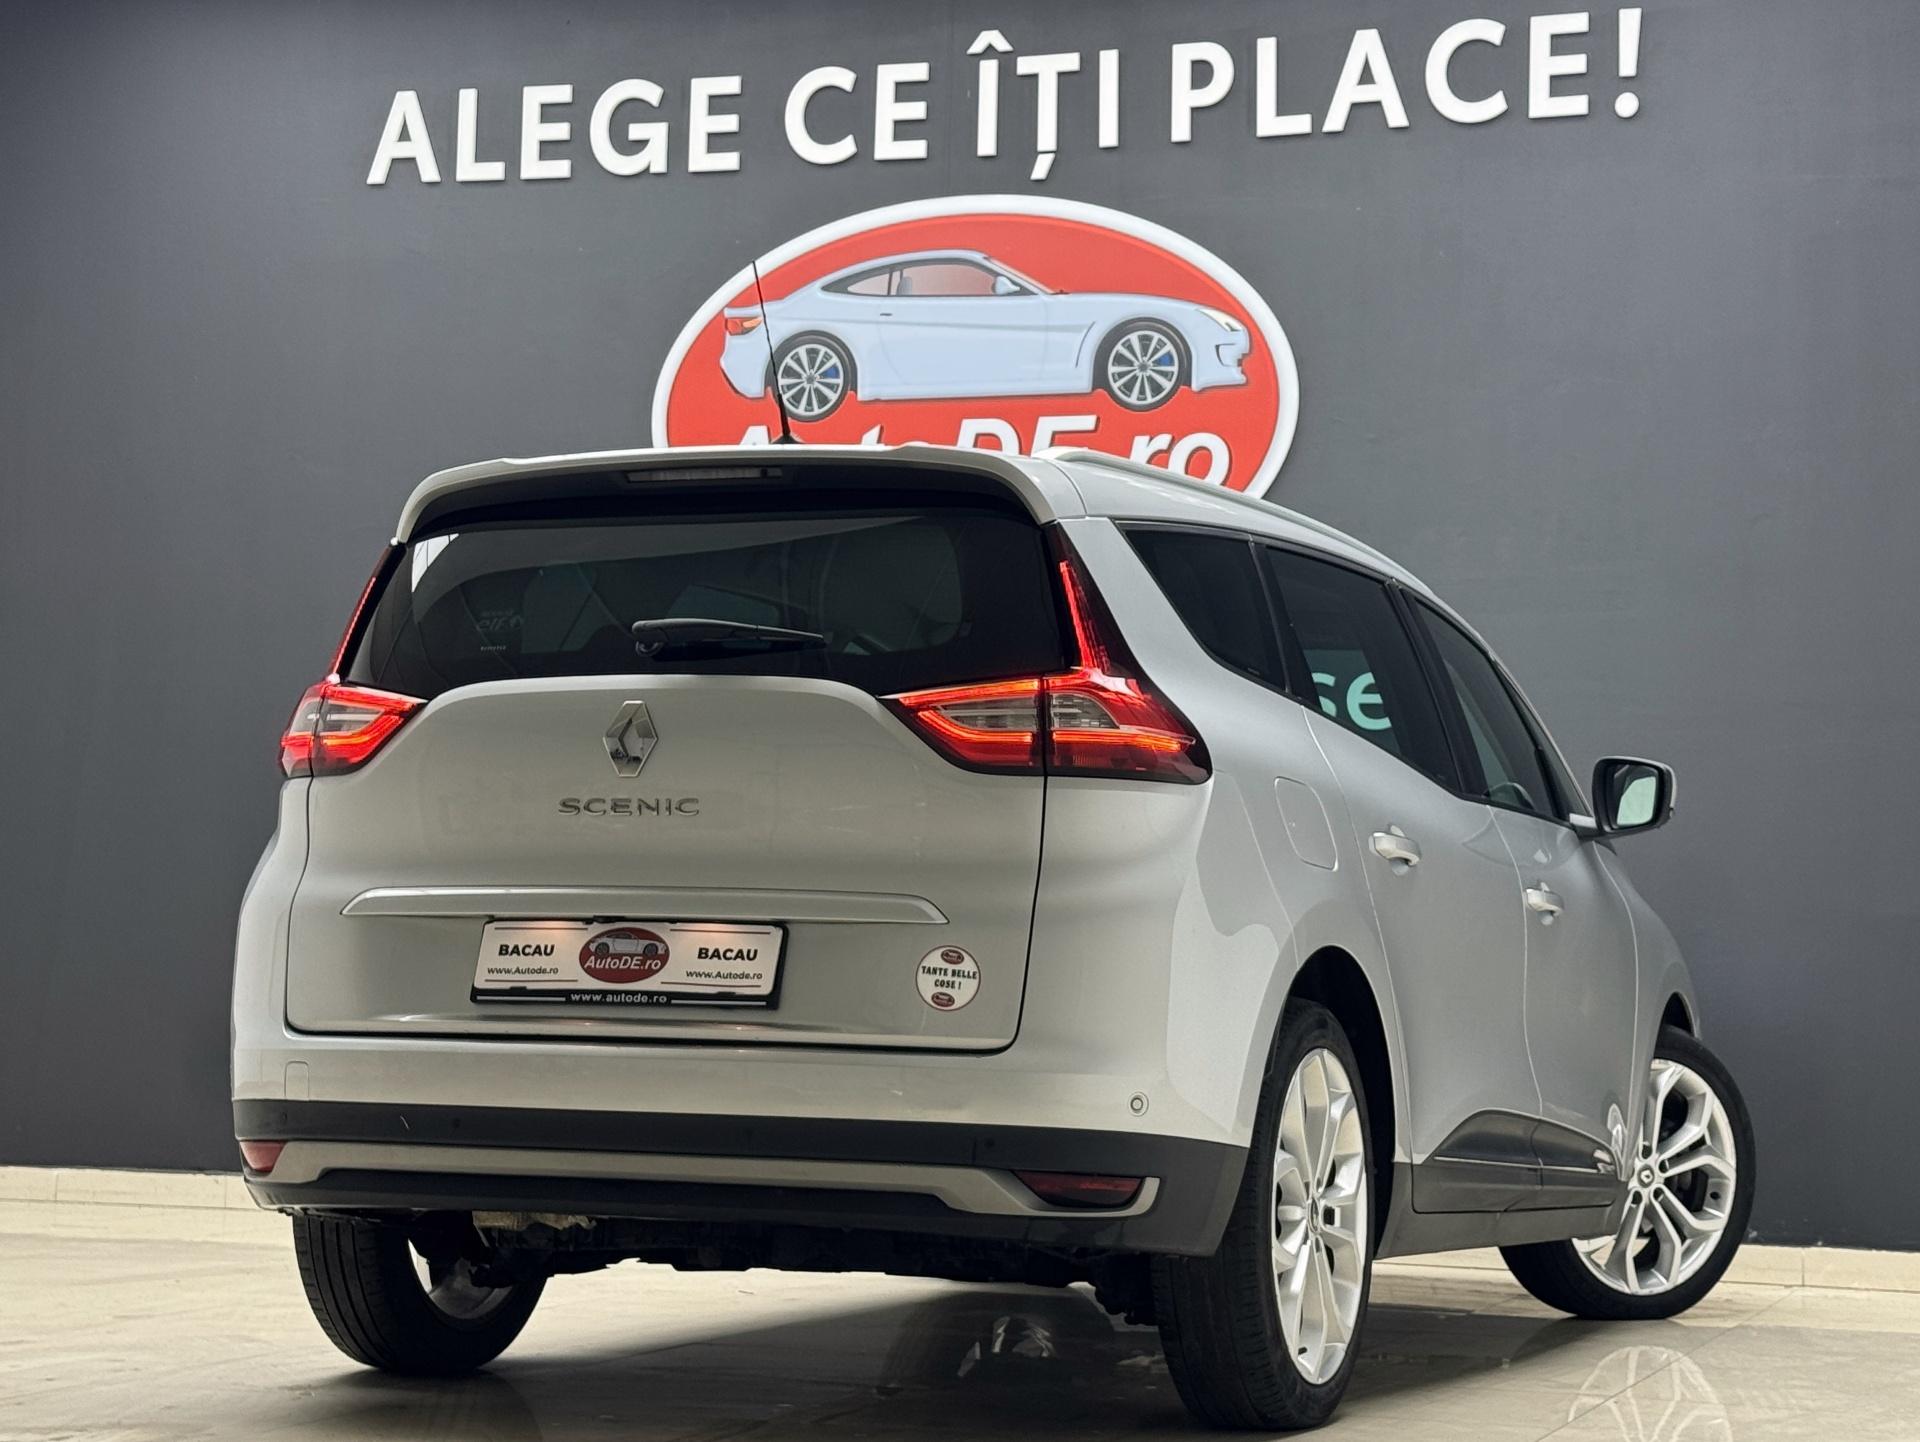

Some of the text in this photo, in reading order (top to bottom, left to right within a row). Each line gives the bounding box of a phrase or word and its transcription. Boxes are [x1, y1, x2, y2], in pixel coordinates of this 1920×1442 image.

[365, 8, 1643, 186] ALEGE CE ÎȚI PLACE!
[558, 797, 700, 816] SCENIC
[498, 944, 555, 957] BACAU
[697, 947, 758, 961] BACAU
[584, 953, 662, 972] AutoDE.ro
[487, 965, 559, 976] www.Autode.ro
[685, 969, 763, 981] www.Autode.ro
[922, 966, 977, 979] TANTE BELLE
[934, 979, 955, 989] COSE
[570, 991, 668, 1004] www.autode.ro
